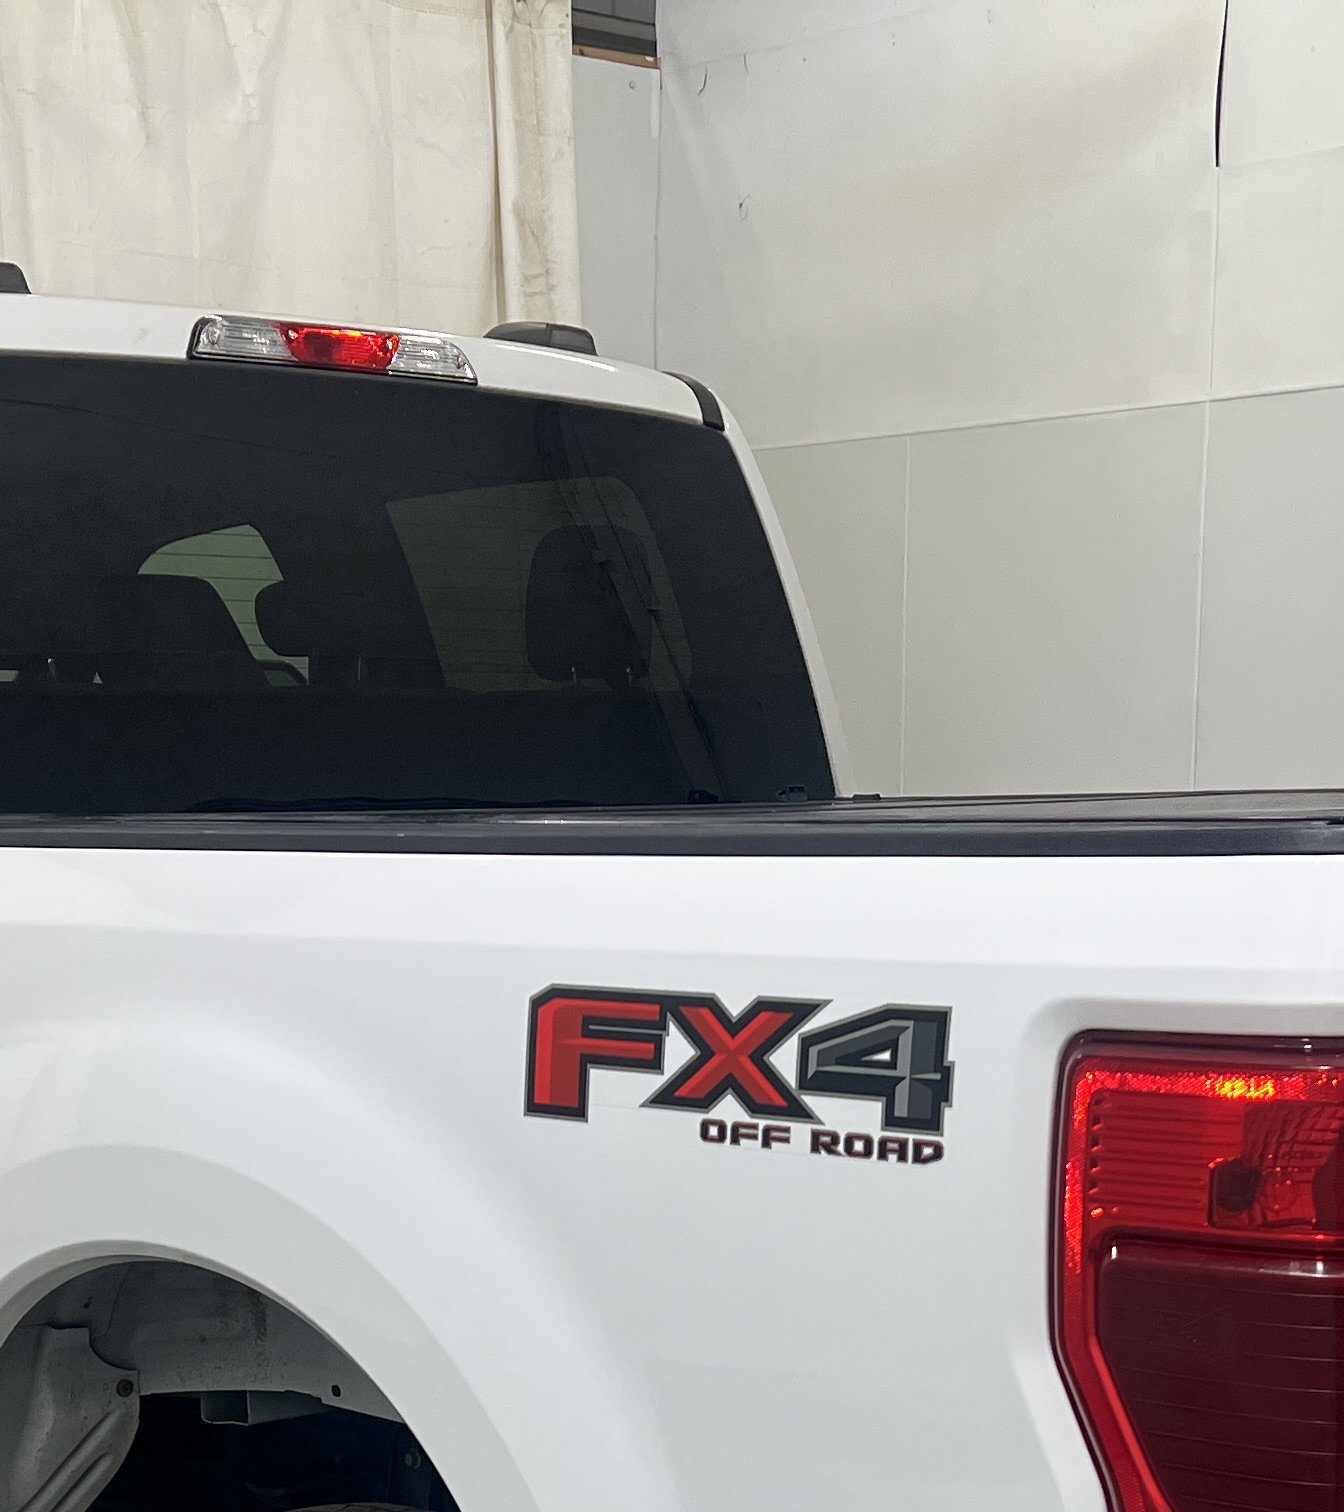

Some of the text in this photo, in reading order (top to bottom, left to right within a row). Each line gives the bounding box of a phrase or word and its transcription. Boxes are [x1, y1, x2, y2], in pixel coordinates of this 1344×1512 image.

[524, 983, 955, 1136] FX4
[699, 1118, 946, 1166] OFF ROAD
